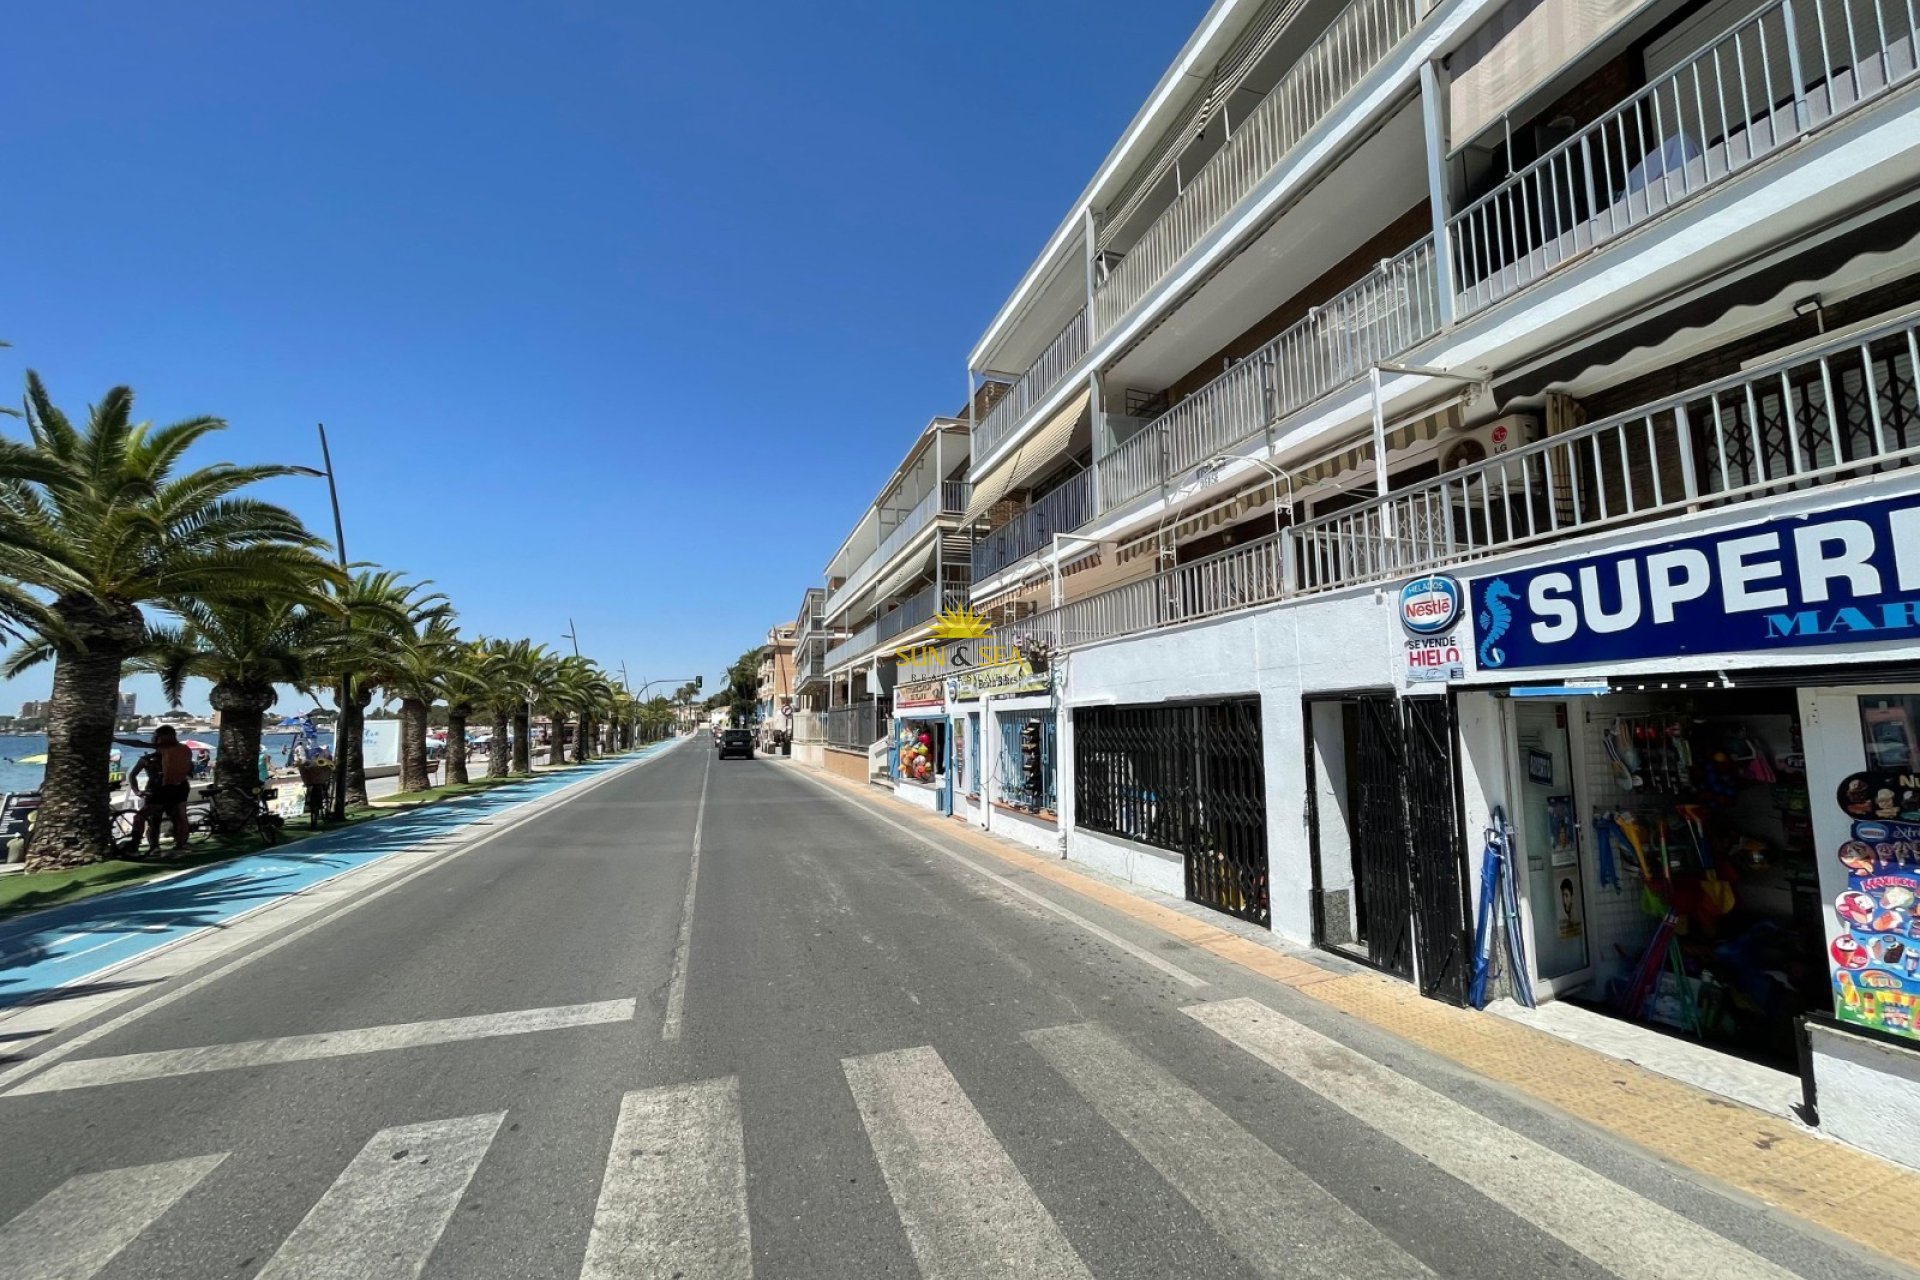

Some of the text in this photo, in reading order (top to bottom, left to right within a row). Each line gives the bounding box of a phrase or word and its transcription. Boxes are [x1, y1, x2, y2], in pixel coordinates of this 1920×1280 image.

[1494, 443, 1507, 454] LG
[1406, 598, 1450, 618] Nestlé
[1408, 636, 1456, 650] SE VENDE
[1409, 647, 1460, 667] HIELO
